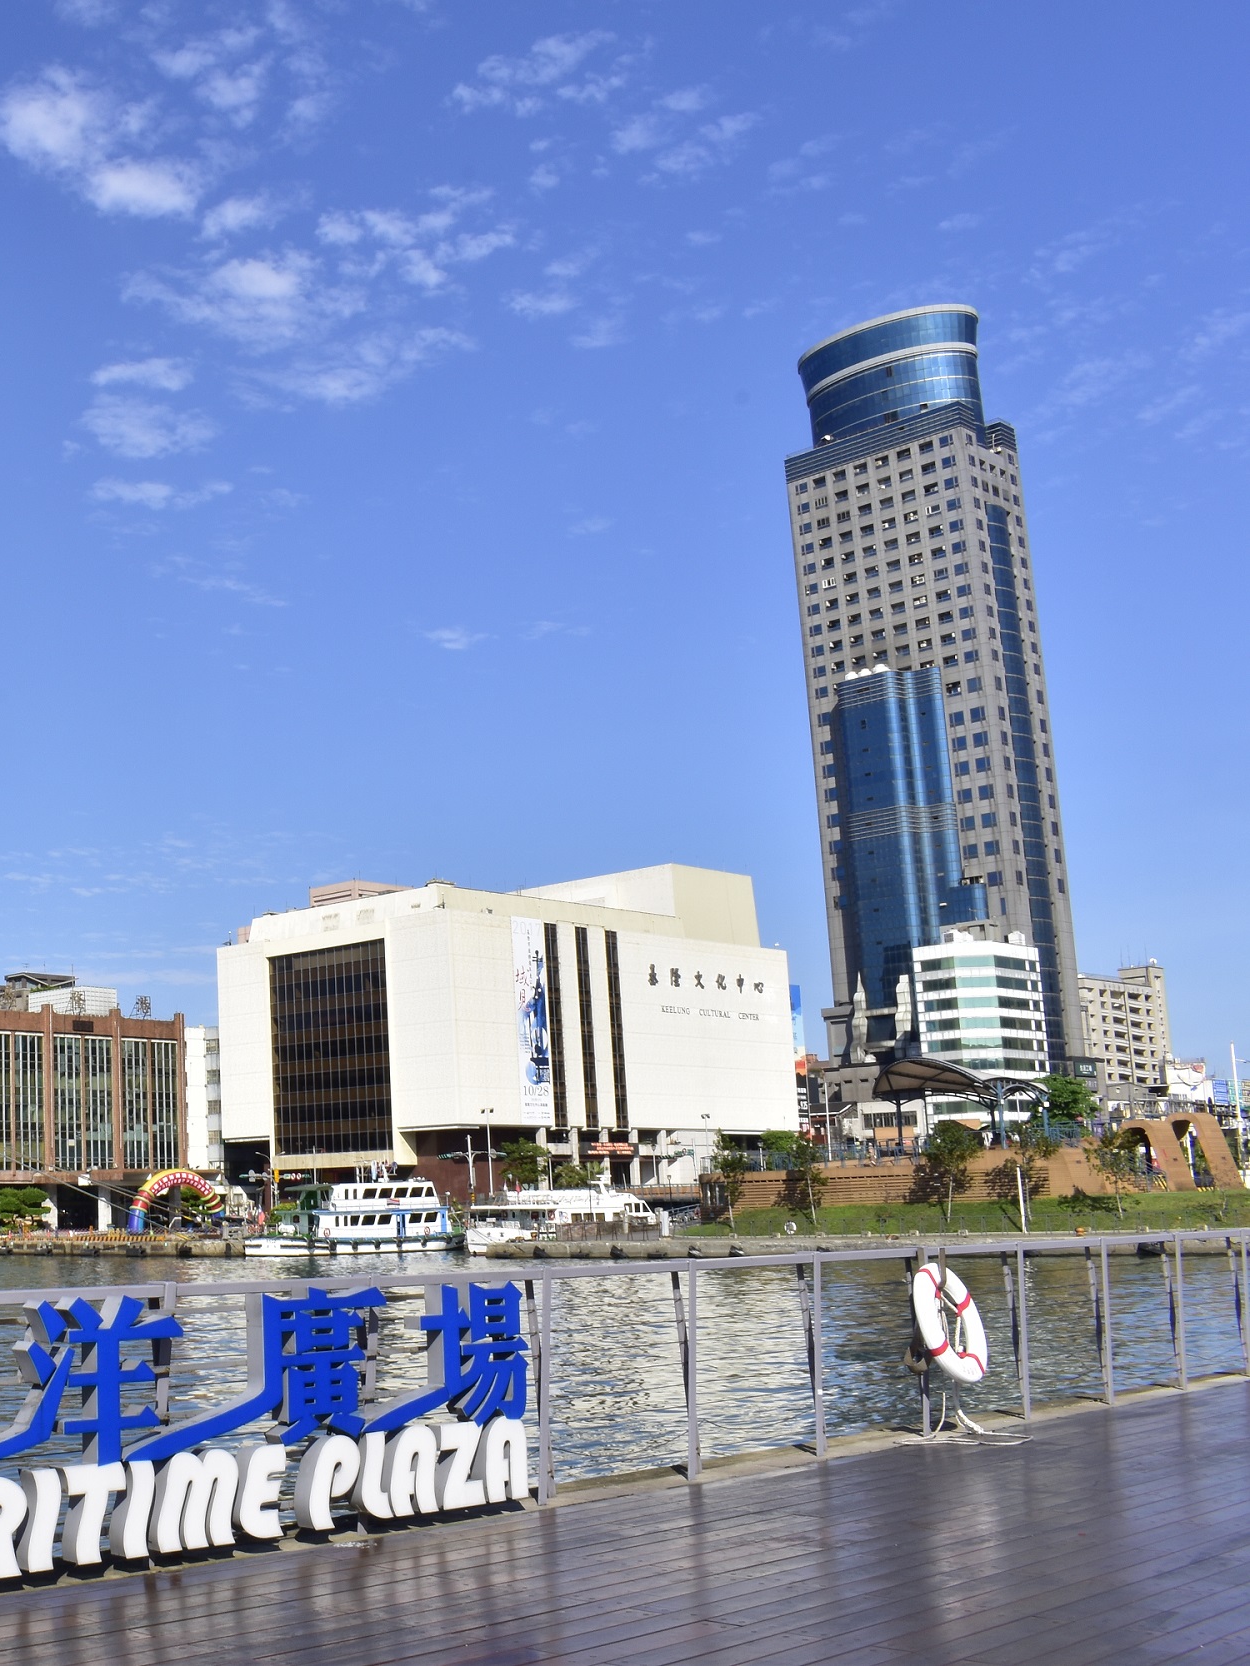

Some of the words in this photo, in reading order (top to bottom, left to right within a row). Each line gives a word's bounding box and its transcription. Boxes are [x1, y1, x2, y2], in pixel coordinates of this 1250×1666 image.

[648, 963, 764, 994] 基隆文化中心
[661, 1005, 691, 1016] KEELUNG
[698, 1008, 731, 1019] CULTURAL
[737, 1012, 760, 1021] CENTER
[523, 1085, 550, 1097] 10/28
[295, 1417, 530, 1532] PLAZA
